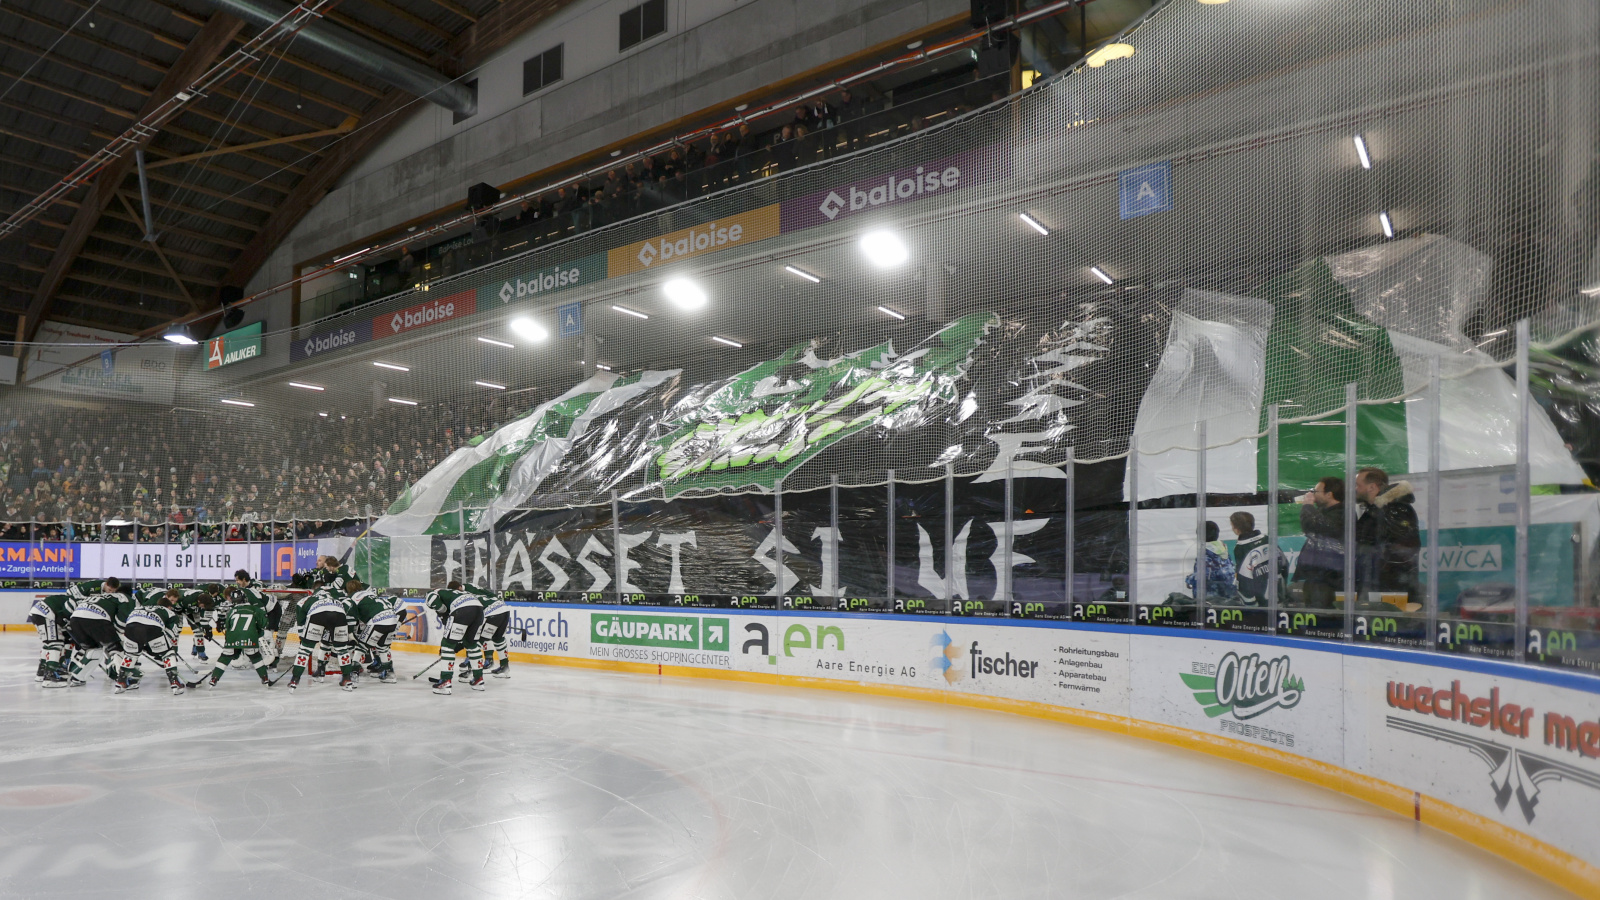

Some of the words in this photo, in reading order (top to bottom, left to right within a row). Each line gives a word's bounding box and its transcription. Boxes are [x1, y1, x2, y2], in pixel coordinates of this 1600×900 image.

[850, 166, 961, 211] baloise
[1137, 181, 1155, 200] A
[660, 223, 743, 260] baloise
[516, 266, 580, 298] baloise
[404, 300, 455, 328] baloise
[566, 314, 574, 326] A
[315, 329, 356, 352] baloise
[223, 345, 257, 365] ANLIKER
[121, 553, 169, 568] ANDR
[176, 554, 231, 568] SPLLER
[229, 613, 254, 632] 17
[595, 616, 694, 642] GÄUPARK
[509, 638, 556, 652] Sonderegger
[557, 641, 569, 652] AG
[1058, 646, 1119, 659] Rohrleitungsbau
[1483, 647, 1505, 656] Energie
[590, 646, 610, 657] MEIN
[612, 648, 649, 660] GROSSES
[651, 651, 730, 666] SHOPPINGCENTER
[969, 640, 1039, 679] fischer
[1058, 658, 1103, 669] Anlagenbau
[816, 658, 844, 671] Aare
[849, 661, 895, 677] Energie
[900, 666, 916, 678] AG
[1058, 670, 1107, 682] Apparatebau
[1191, 661, 1216, 676] EHC
[1058, 681, 1101, 694] Fernwärme
[1214, 651, 1300, 714] Olten
[1386, 679, 1535, 739] wechsler
[1219, 718, 1295, 748] PROSPECTS
